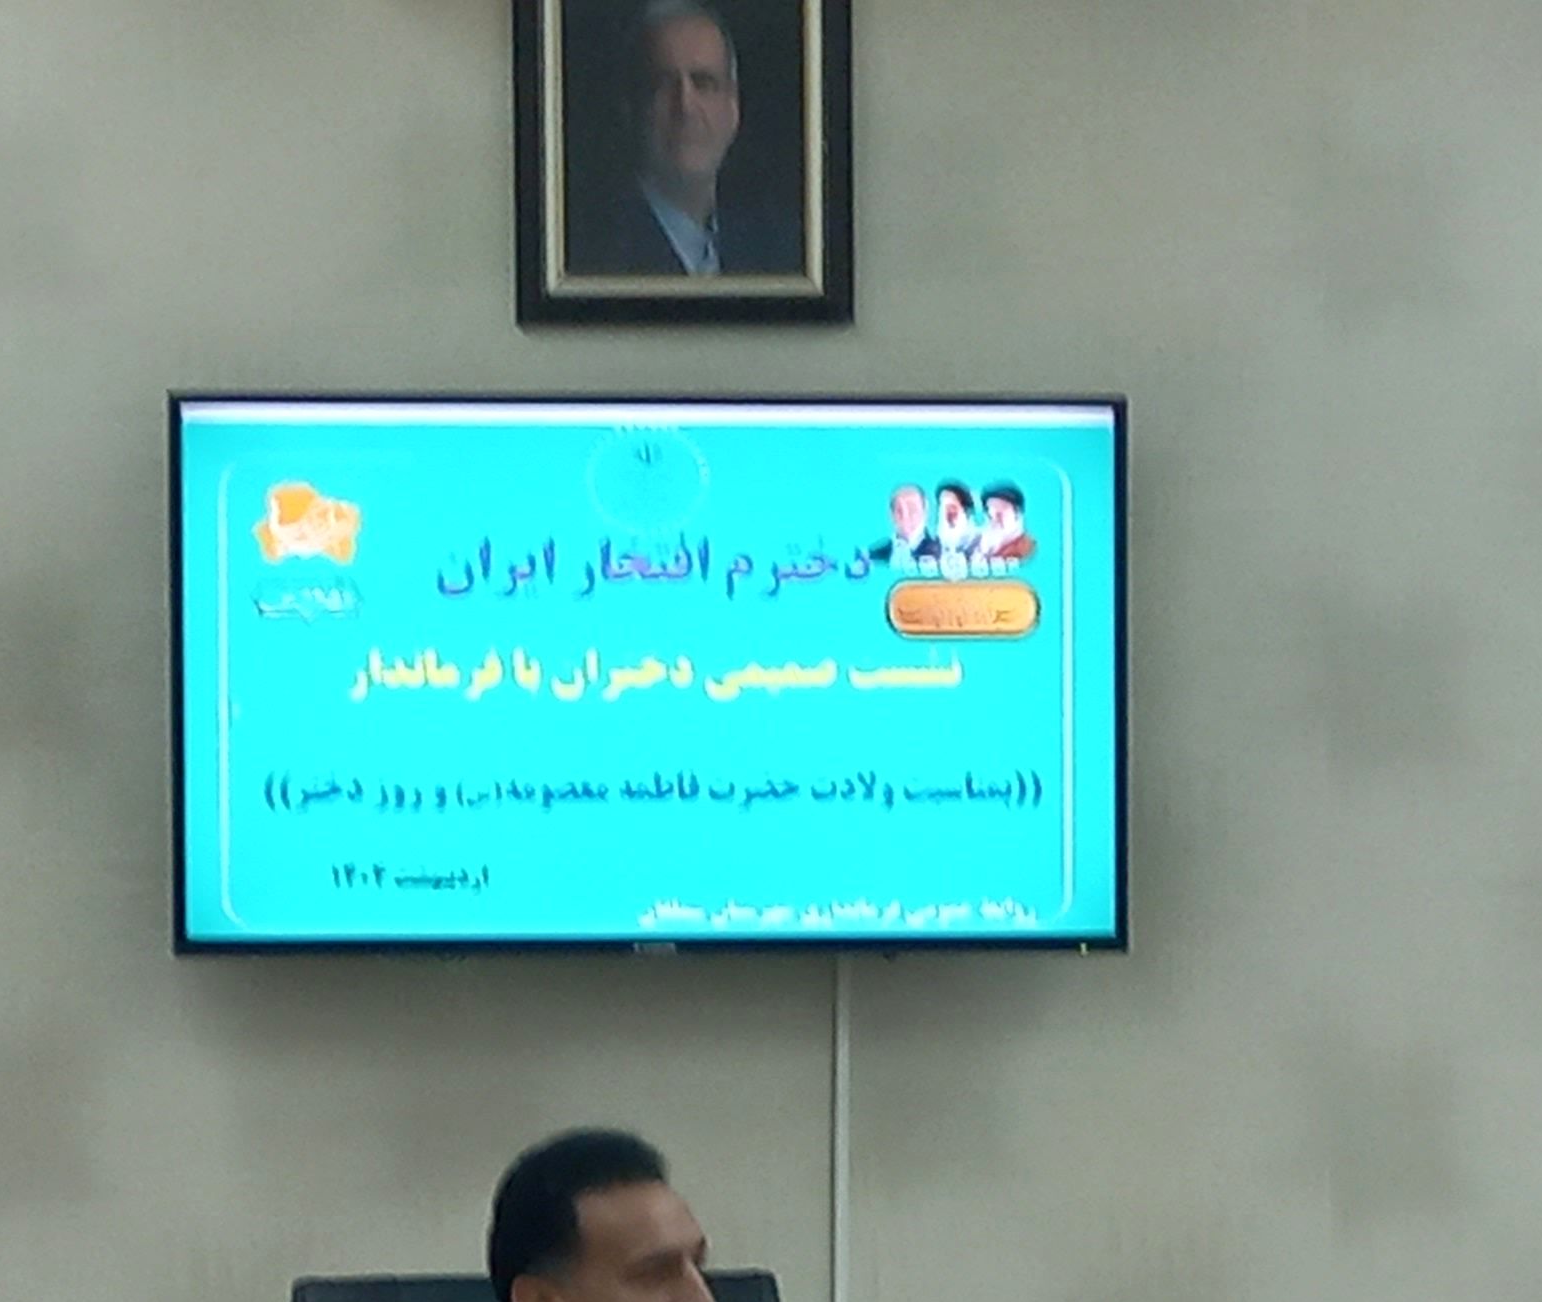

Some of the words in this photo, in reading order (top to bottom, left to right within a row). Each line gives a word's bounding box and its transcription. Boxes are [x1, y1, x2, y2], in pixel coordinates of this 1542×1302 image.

[435, 534, 556, 600] ایران
[574, 529, 711, 599] افتخار
[726, 531, 873, 601] دخترم
[348, 645, 504, 703] فرماندار
[510, 645, 542, 697] با
[551, 646, 695, 703] دختران
[705, 656, 837, 703] صمیمی
[847, 643, 965, 691] نشست
[376, 781, 423, 814] روز
[434, 782, 447, 815] و
[619, 769, 700, 802] فاطمه
[708, 769, 800, 812] حضرت
[811, 769, 895, 812] ولادت
